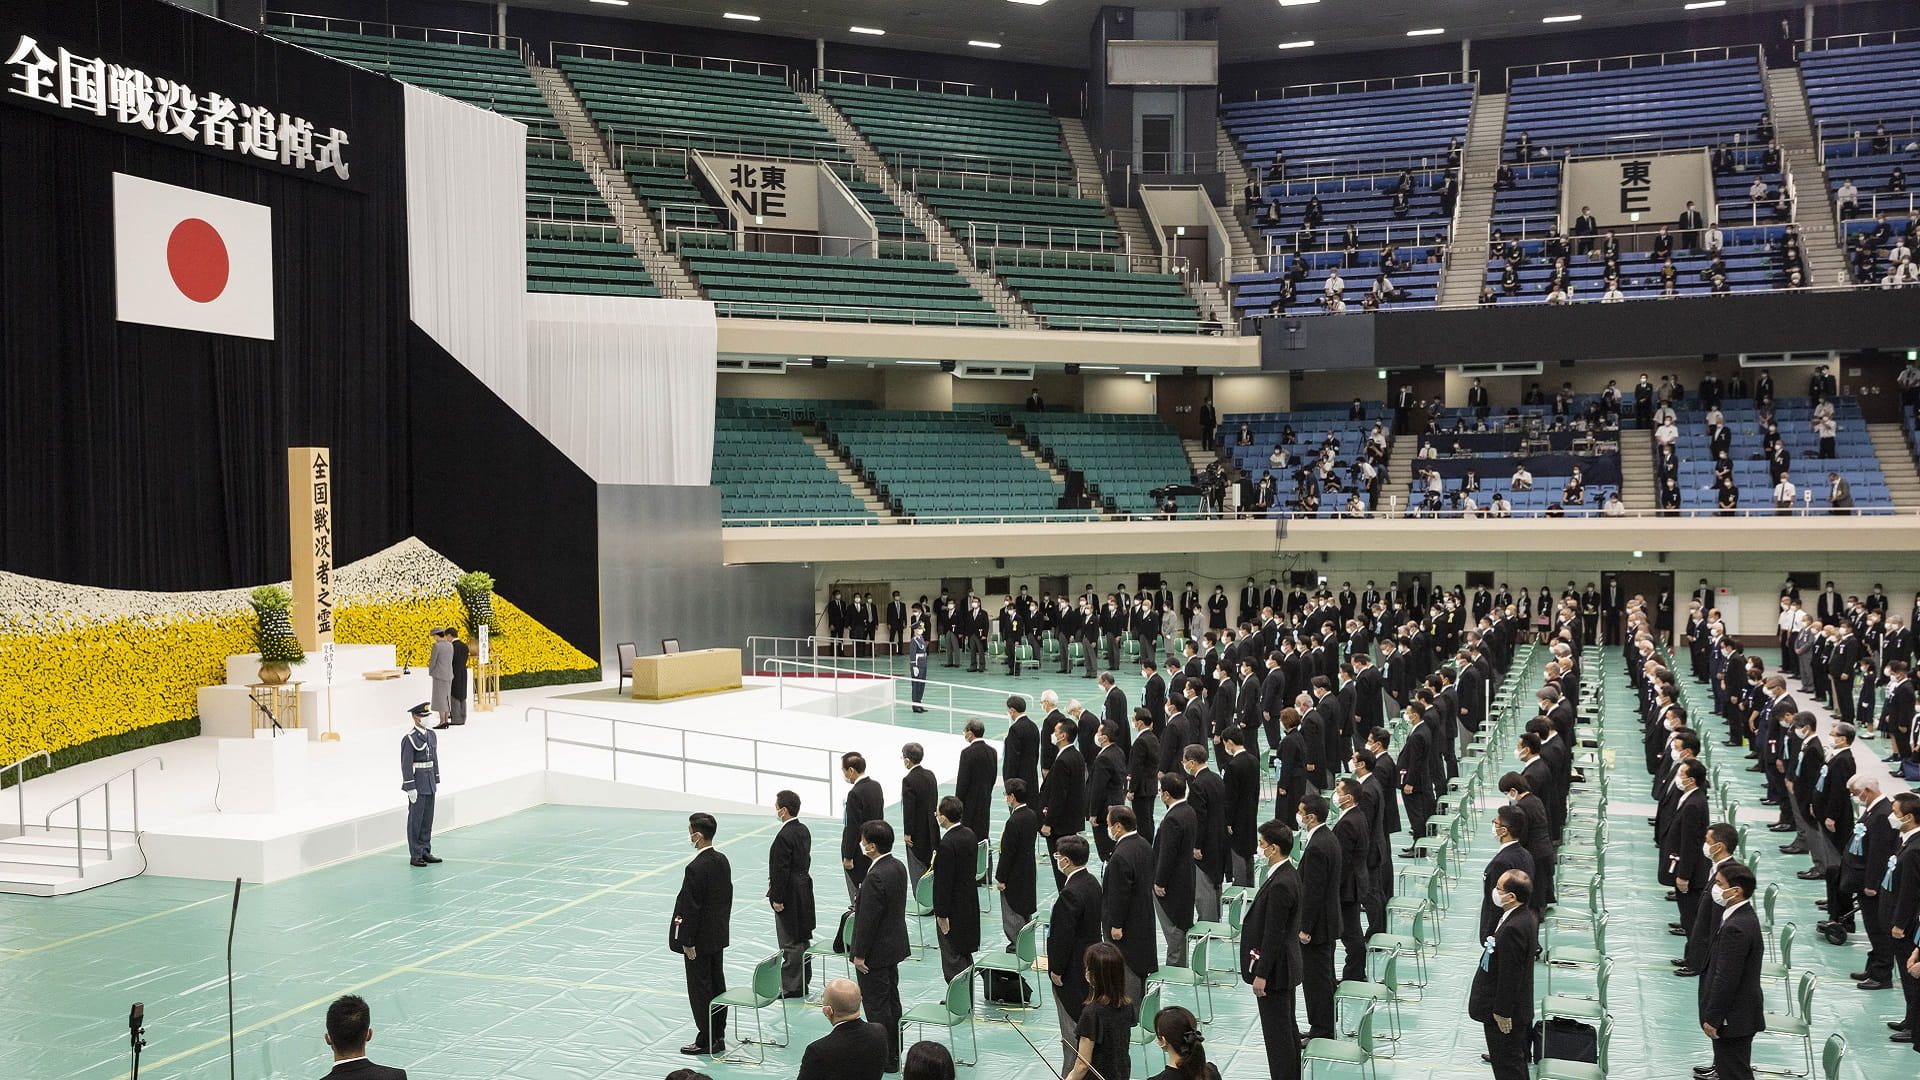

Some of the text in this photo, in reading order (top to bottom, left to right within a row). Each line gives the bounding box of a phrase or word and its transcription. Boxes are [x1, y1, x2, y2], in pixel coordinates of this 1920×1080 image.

[4, 35, 350, 181] 全国戦没者追悼式
[730, 164, 787, 190] 北東
[1620, 161, 1651, 187] 東
[731, 190, 787, 217] NE
[1621, 186, 1651, 213] E
[312, 452, 332, 634] 全国戦没者之霊
